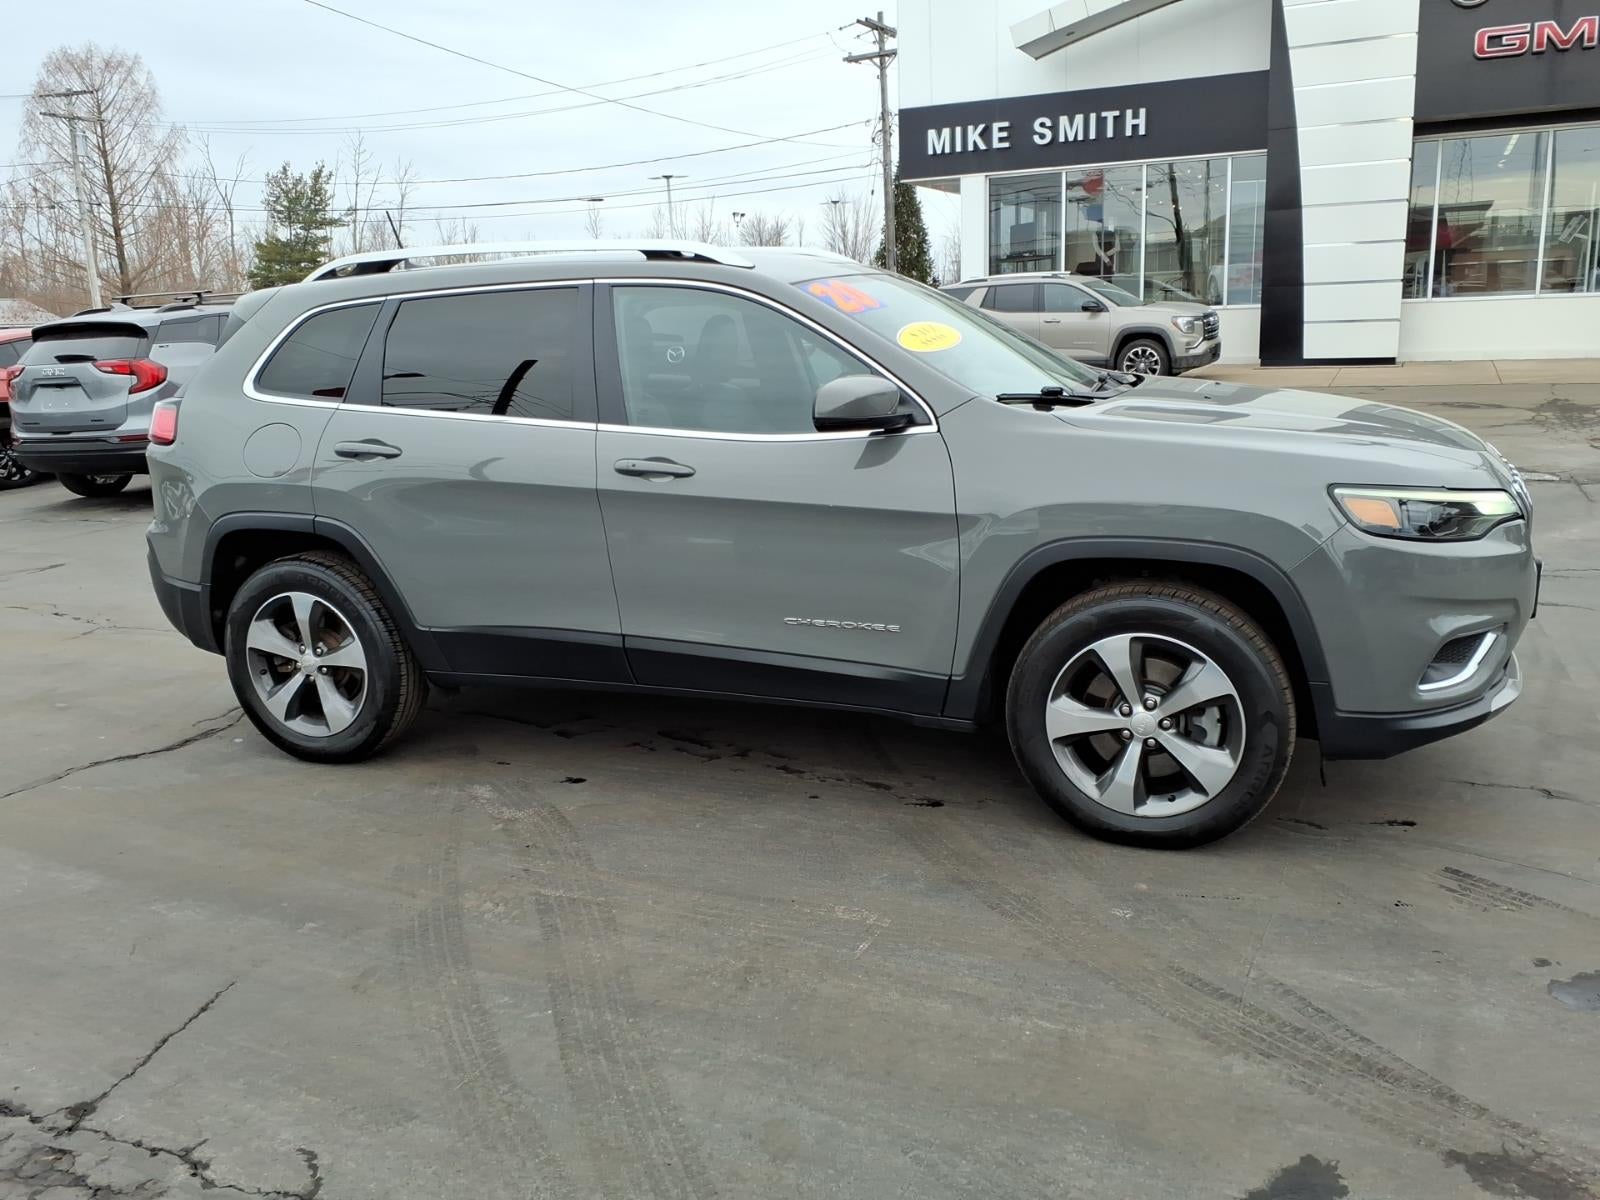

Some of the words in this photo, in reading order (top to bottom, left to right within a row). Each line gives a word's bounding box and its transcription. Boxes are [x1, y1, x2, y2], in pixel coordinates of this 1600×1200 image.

[927, 121, 1011, 156] MIKE
[1032, 107, 1147, 146] SMITH
[783, 617, 901, 633] CHEROKEE
